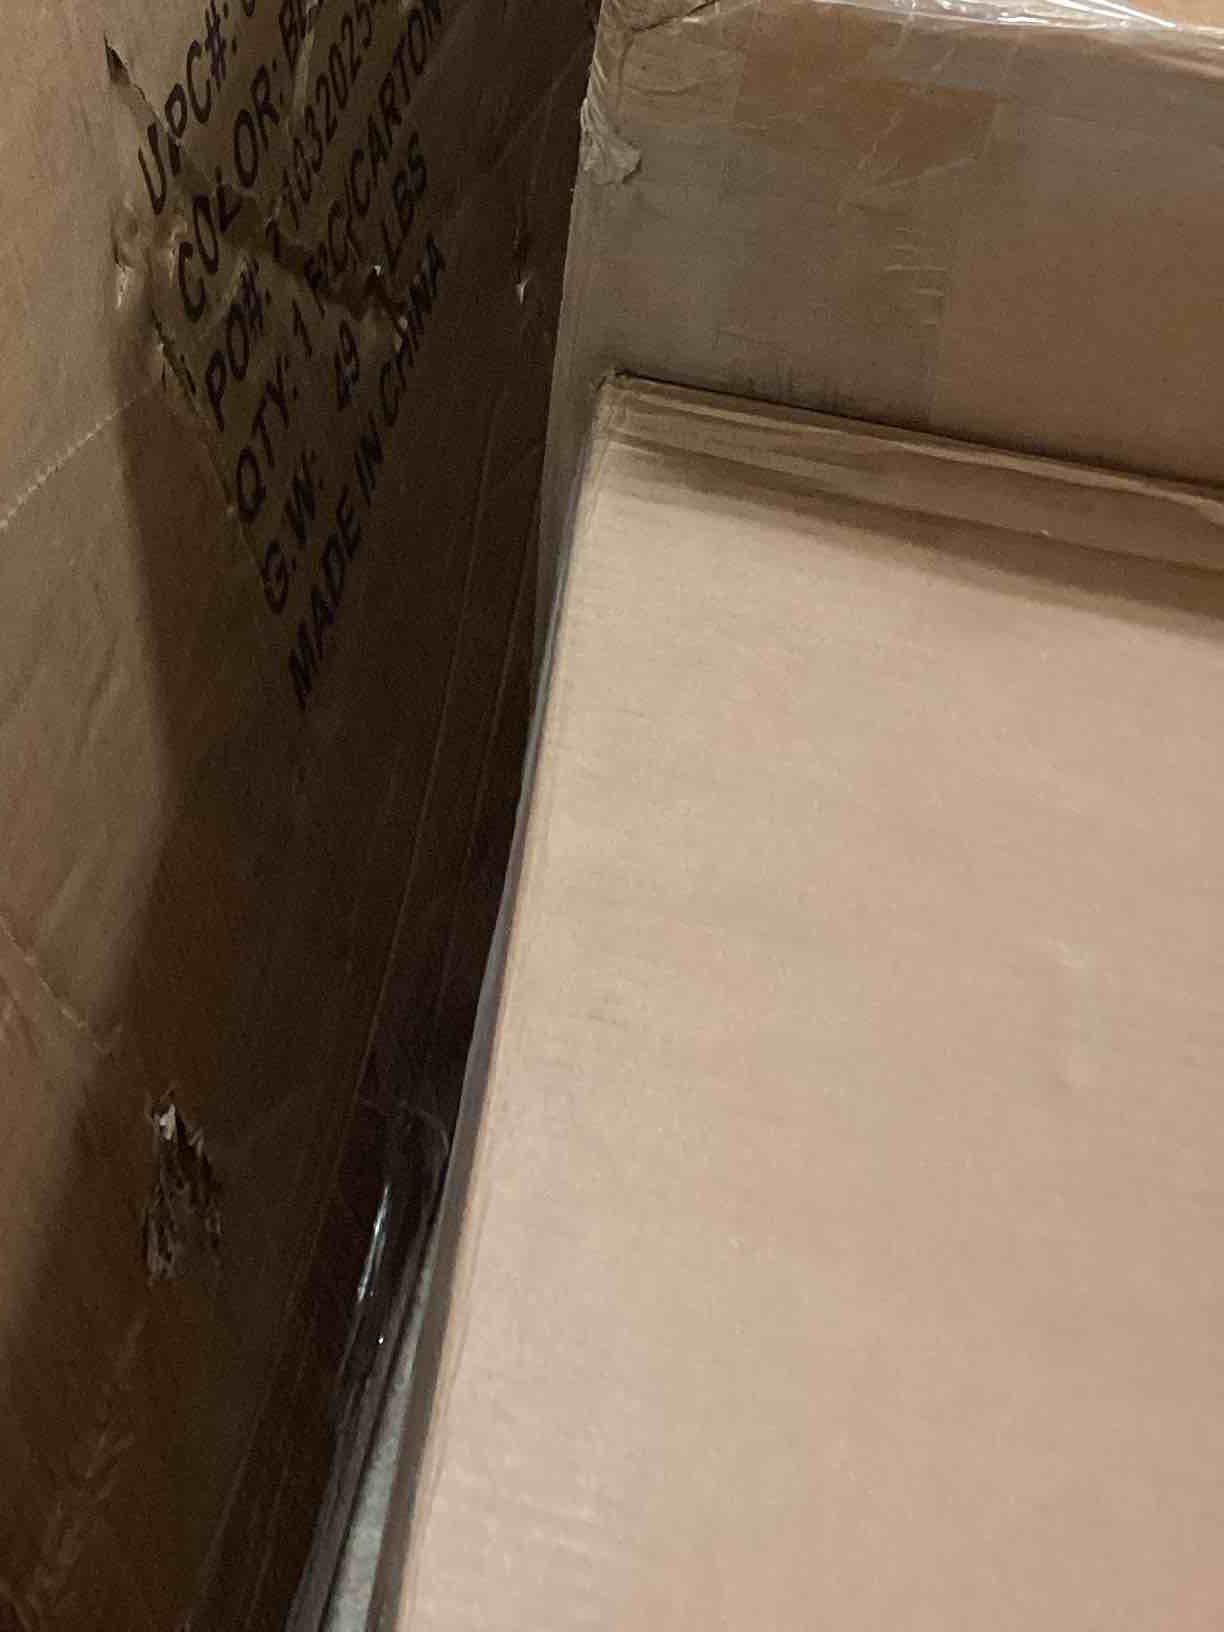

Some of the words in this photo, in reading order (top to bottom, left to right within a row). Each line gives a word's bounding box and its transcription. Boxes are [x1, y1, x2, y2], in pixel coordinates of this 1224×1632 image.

[177, 57, 284, 323] COLOR:
[334, 319, 361, 412] 49
[380, 130, 427, 268] LBS
[235, 352, 299, 525] QTY:
[288, 482, 362, 713] MADE
[353, 408, 384, 508] IN
[378, 232, 447, 429] CHINA
